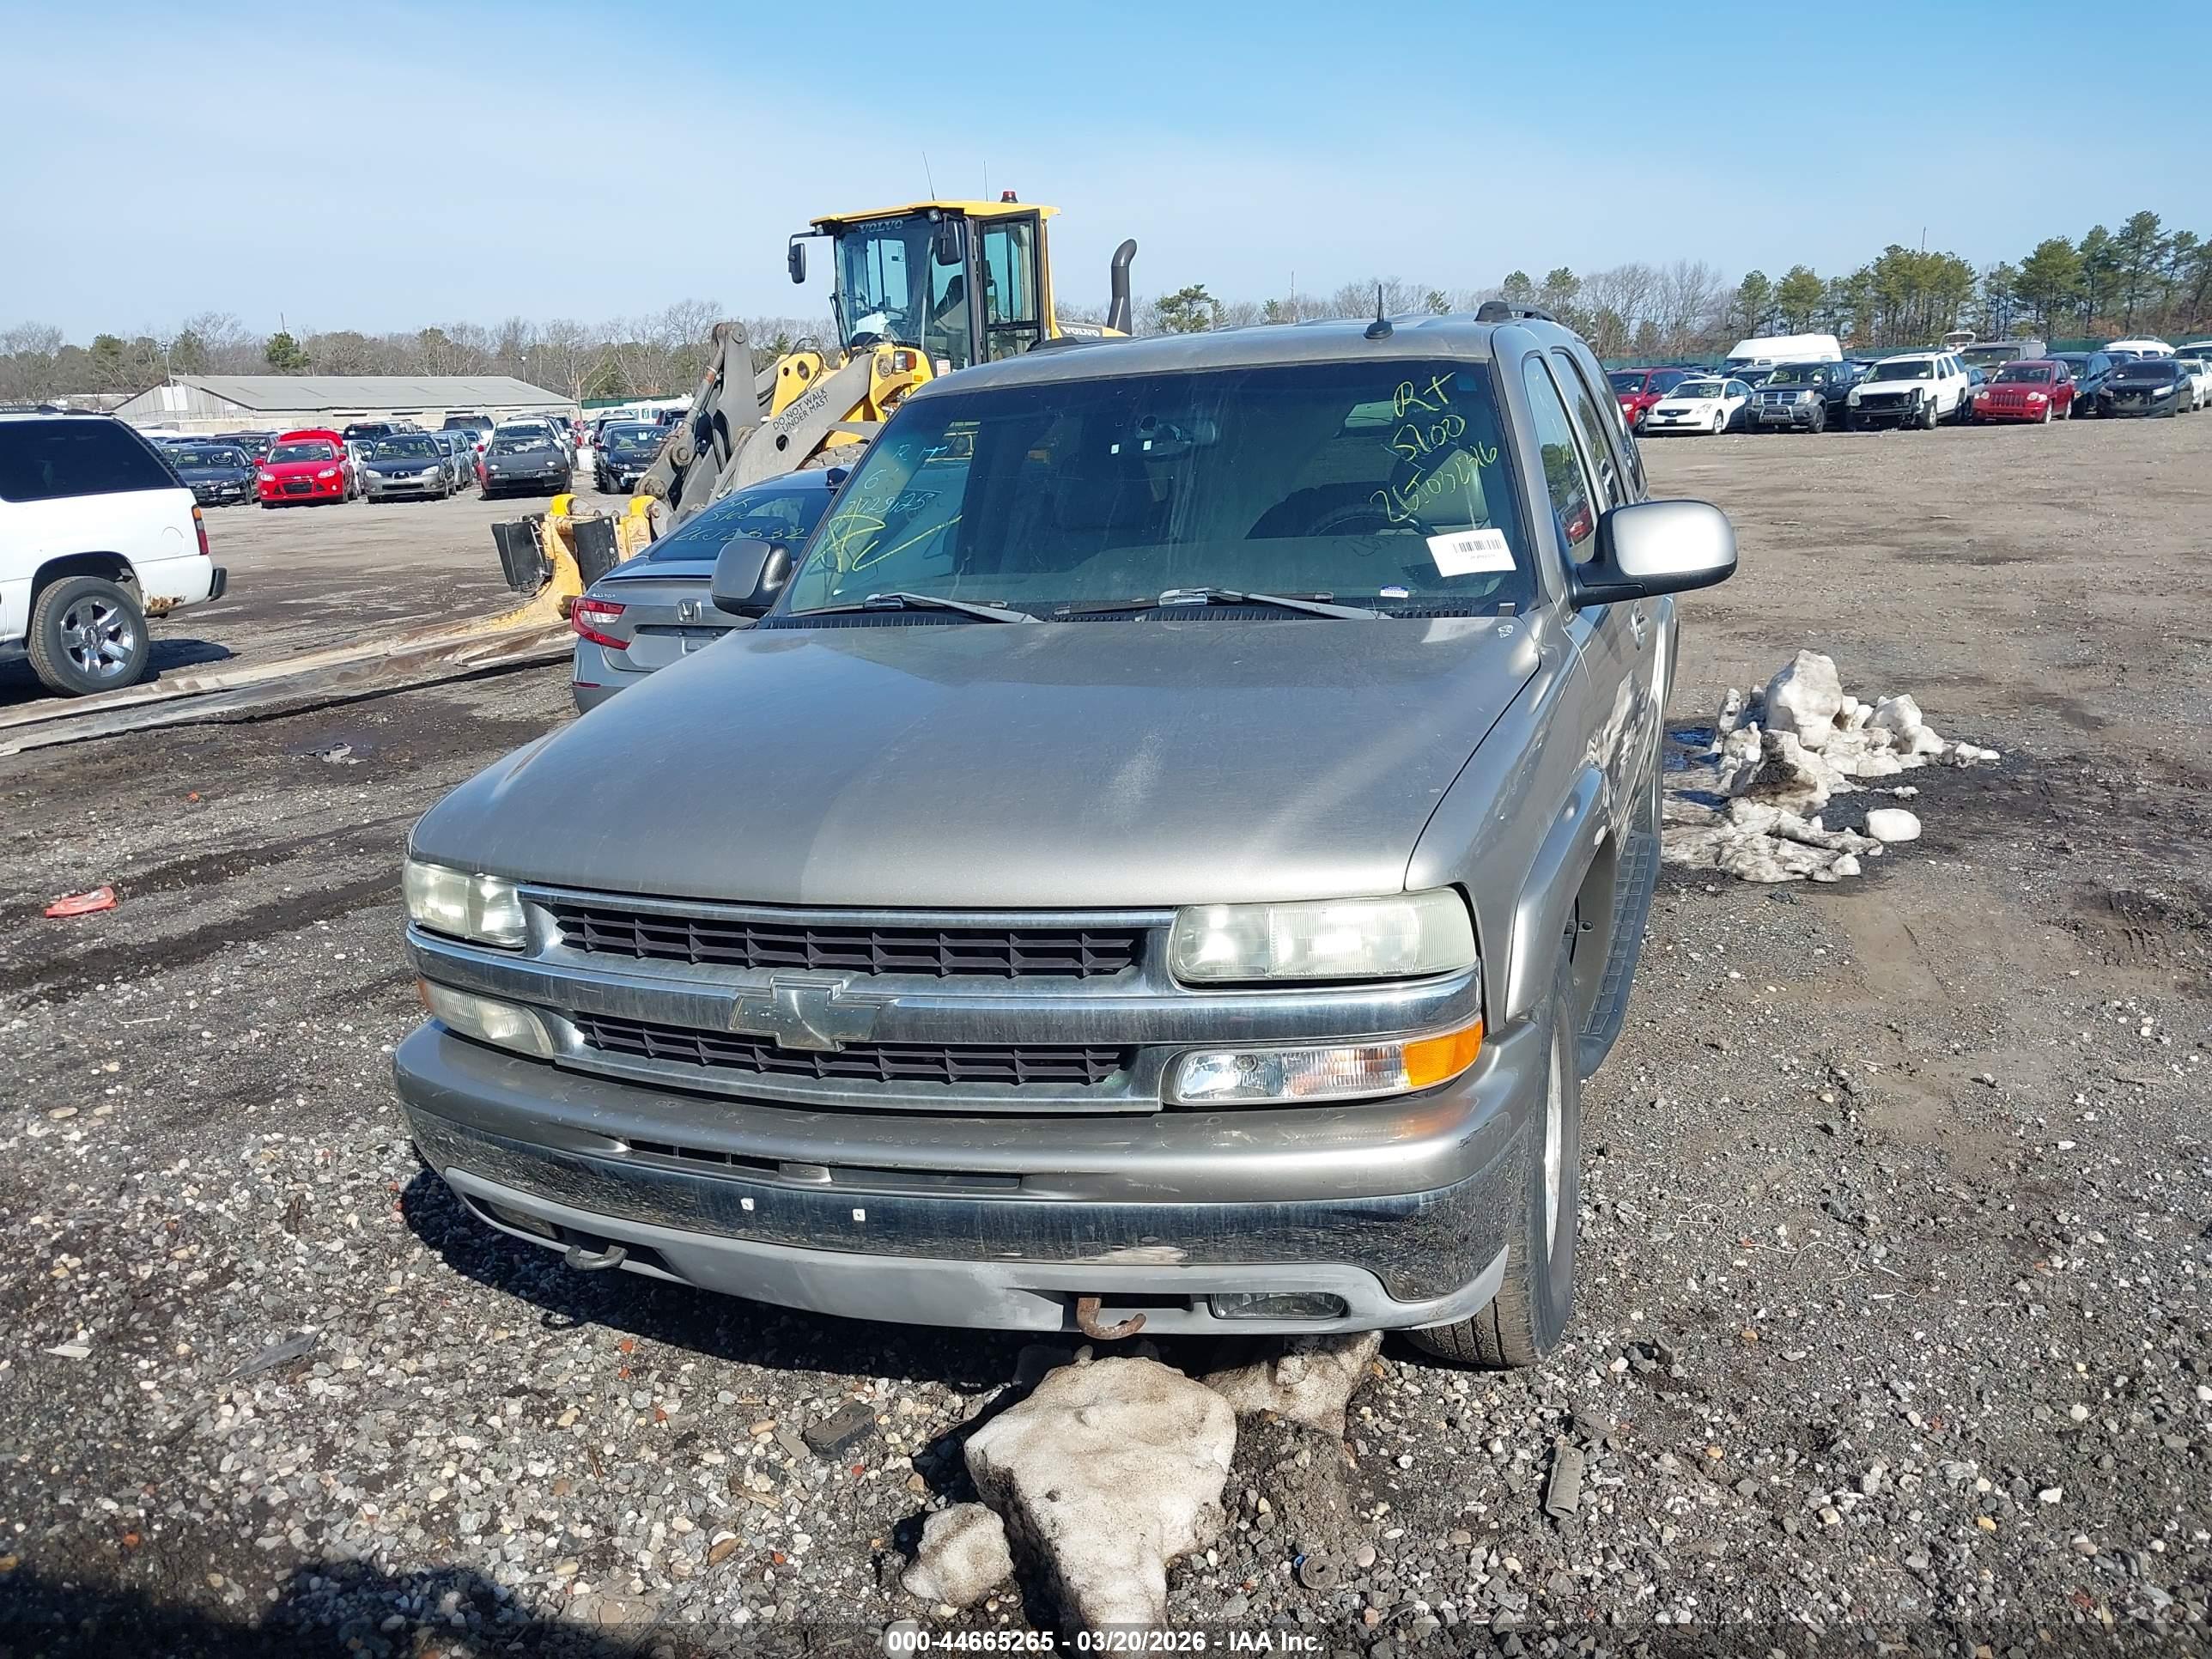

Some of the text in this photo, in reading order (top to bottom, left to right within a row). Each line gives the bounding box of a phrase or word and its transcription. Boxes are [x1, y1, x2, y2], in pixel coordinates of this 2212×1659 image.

[859, 220, 903, 234] VOLVO
[1060, 326, 1100, 337] VOLVO
[773, 386, 827, 430] DO NOT WALK
[781, 395, 830, 432] UNDER MAST
